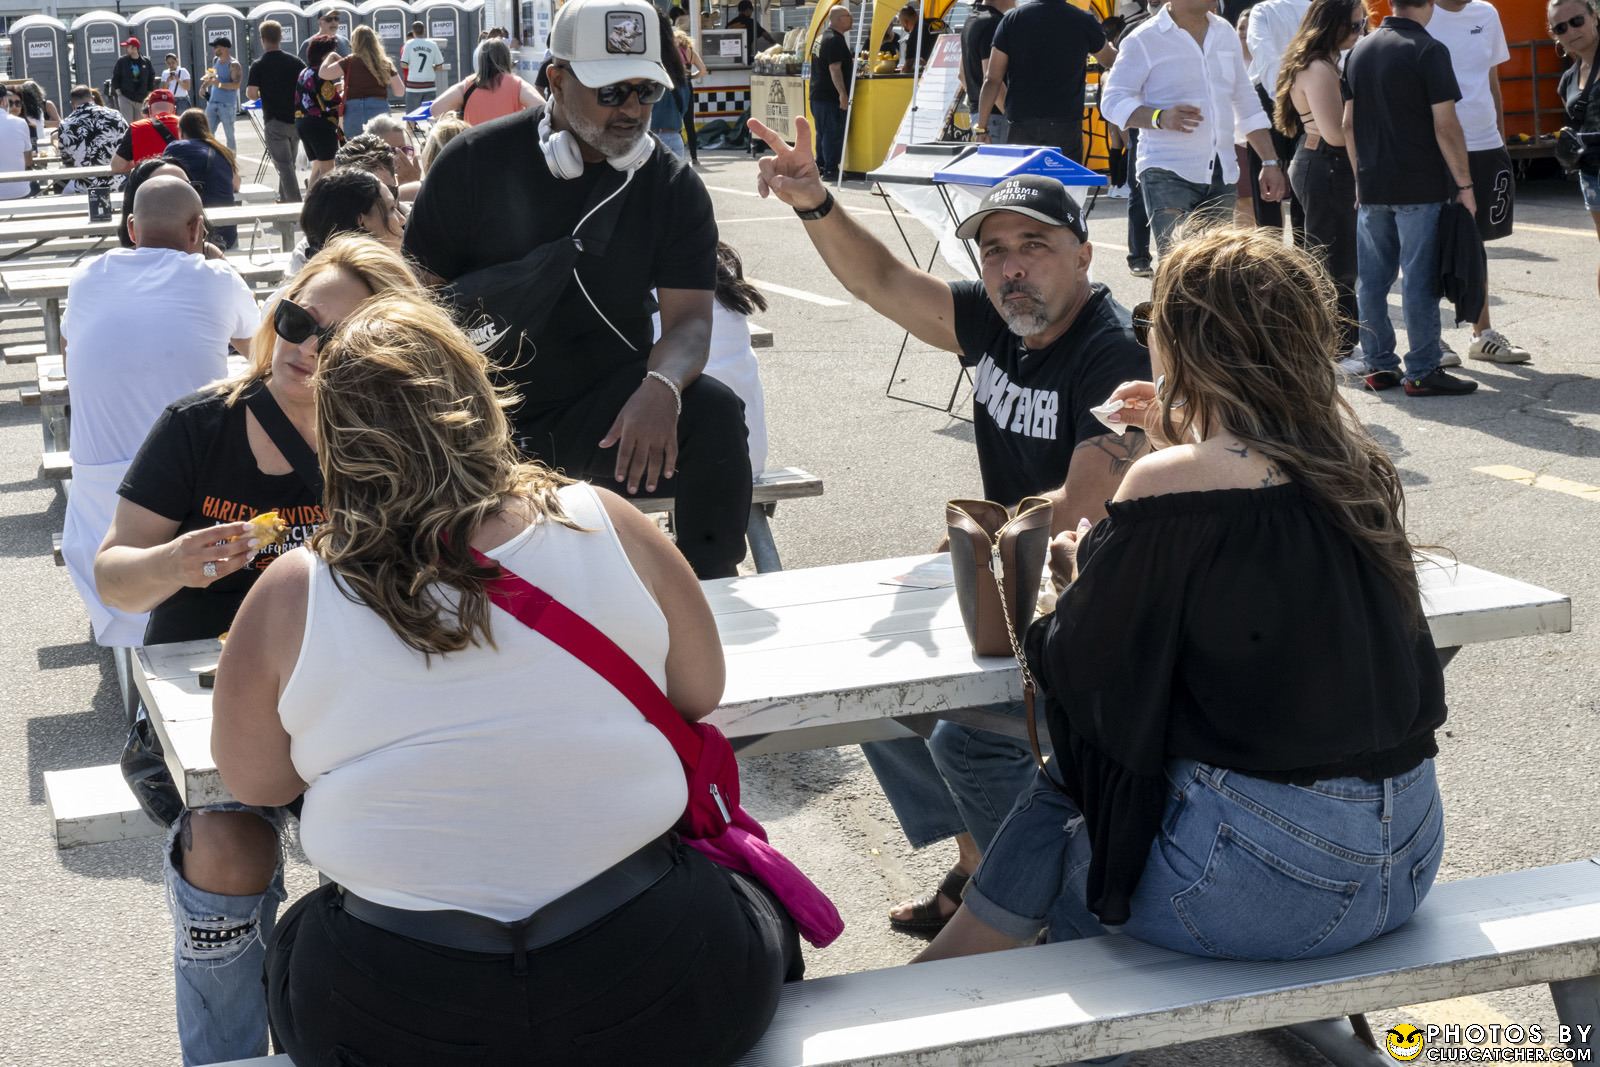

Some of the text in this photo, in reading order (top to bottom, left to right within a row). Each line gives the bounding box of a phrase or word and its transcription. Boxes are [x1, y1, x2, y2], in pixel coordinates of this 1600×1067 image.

[418, 53, 428, 73] 7
[1489, 169, 1511, 225] 3
[202, 496, 258, 522] HARLEY
